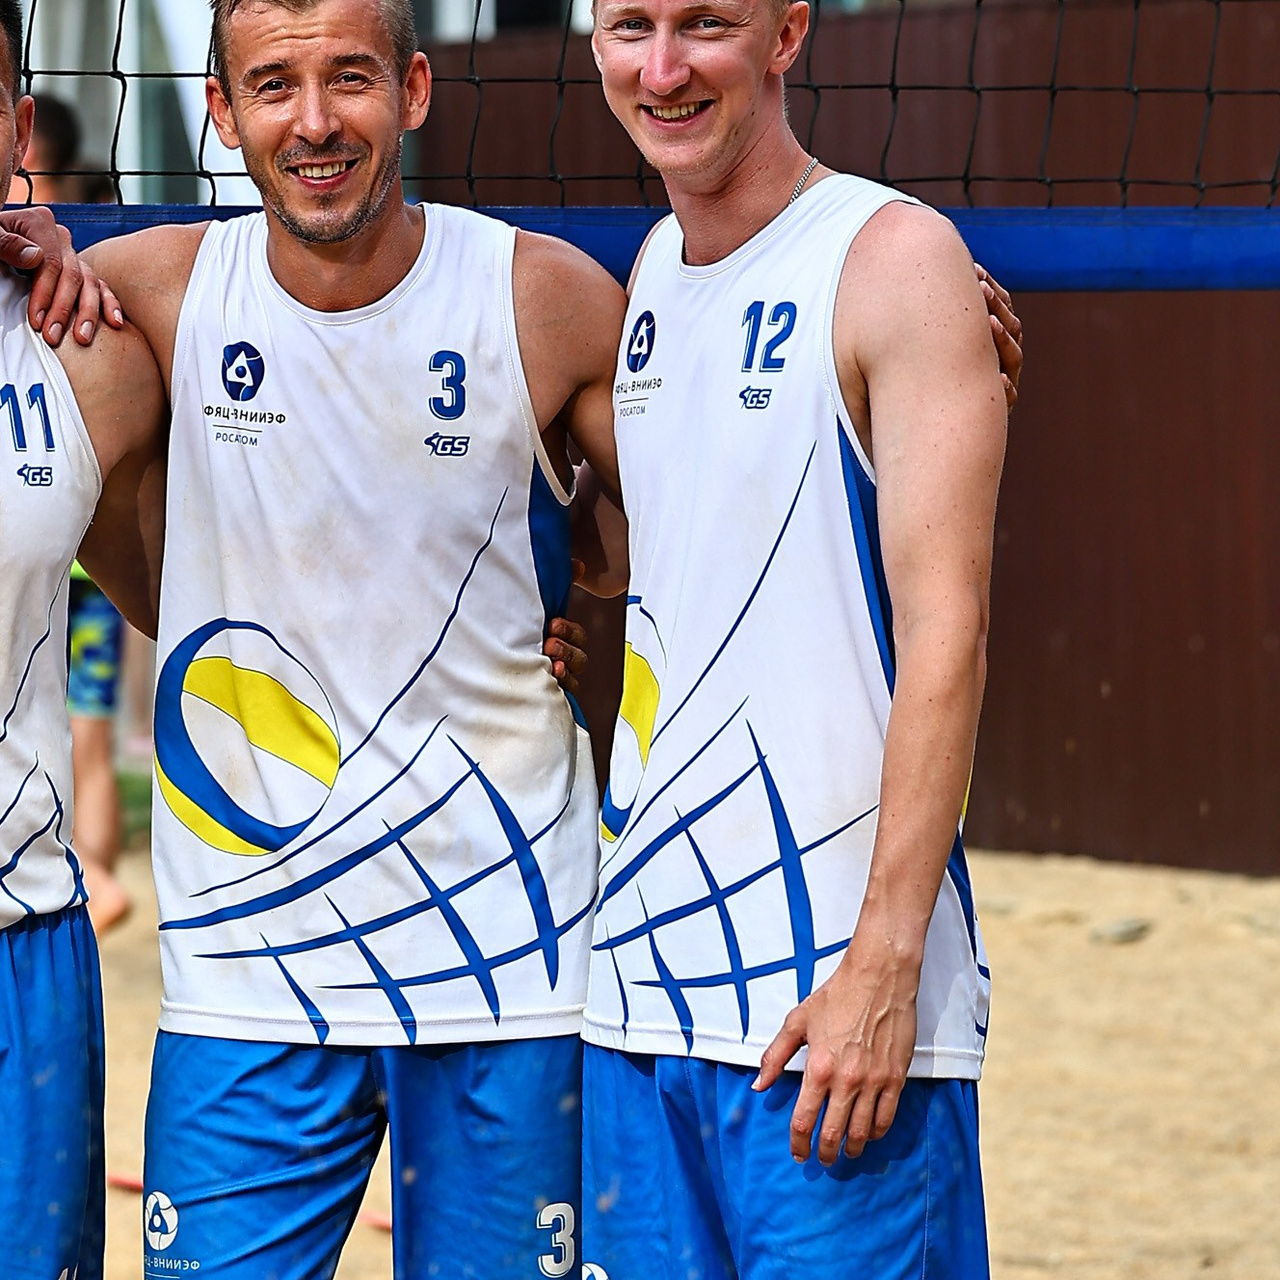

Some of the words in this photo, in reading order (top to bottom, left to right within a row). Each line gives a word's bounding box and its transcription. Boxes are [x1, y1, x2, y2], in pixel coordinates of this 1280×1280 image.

[741, 301, 797, 372] 12
[202, 405, 286, 424] ФЯЦ-ВНИИЭФ
[428, 350, 467, 420] 3
[620, 405, 646, 418] РОСАТОМ
[536, 1202, 575, 1278] 3
